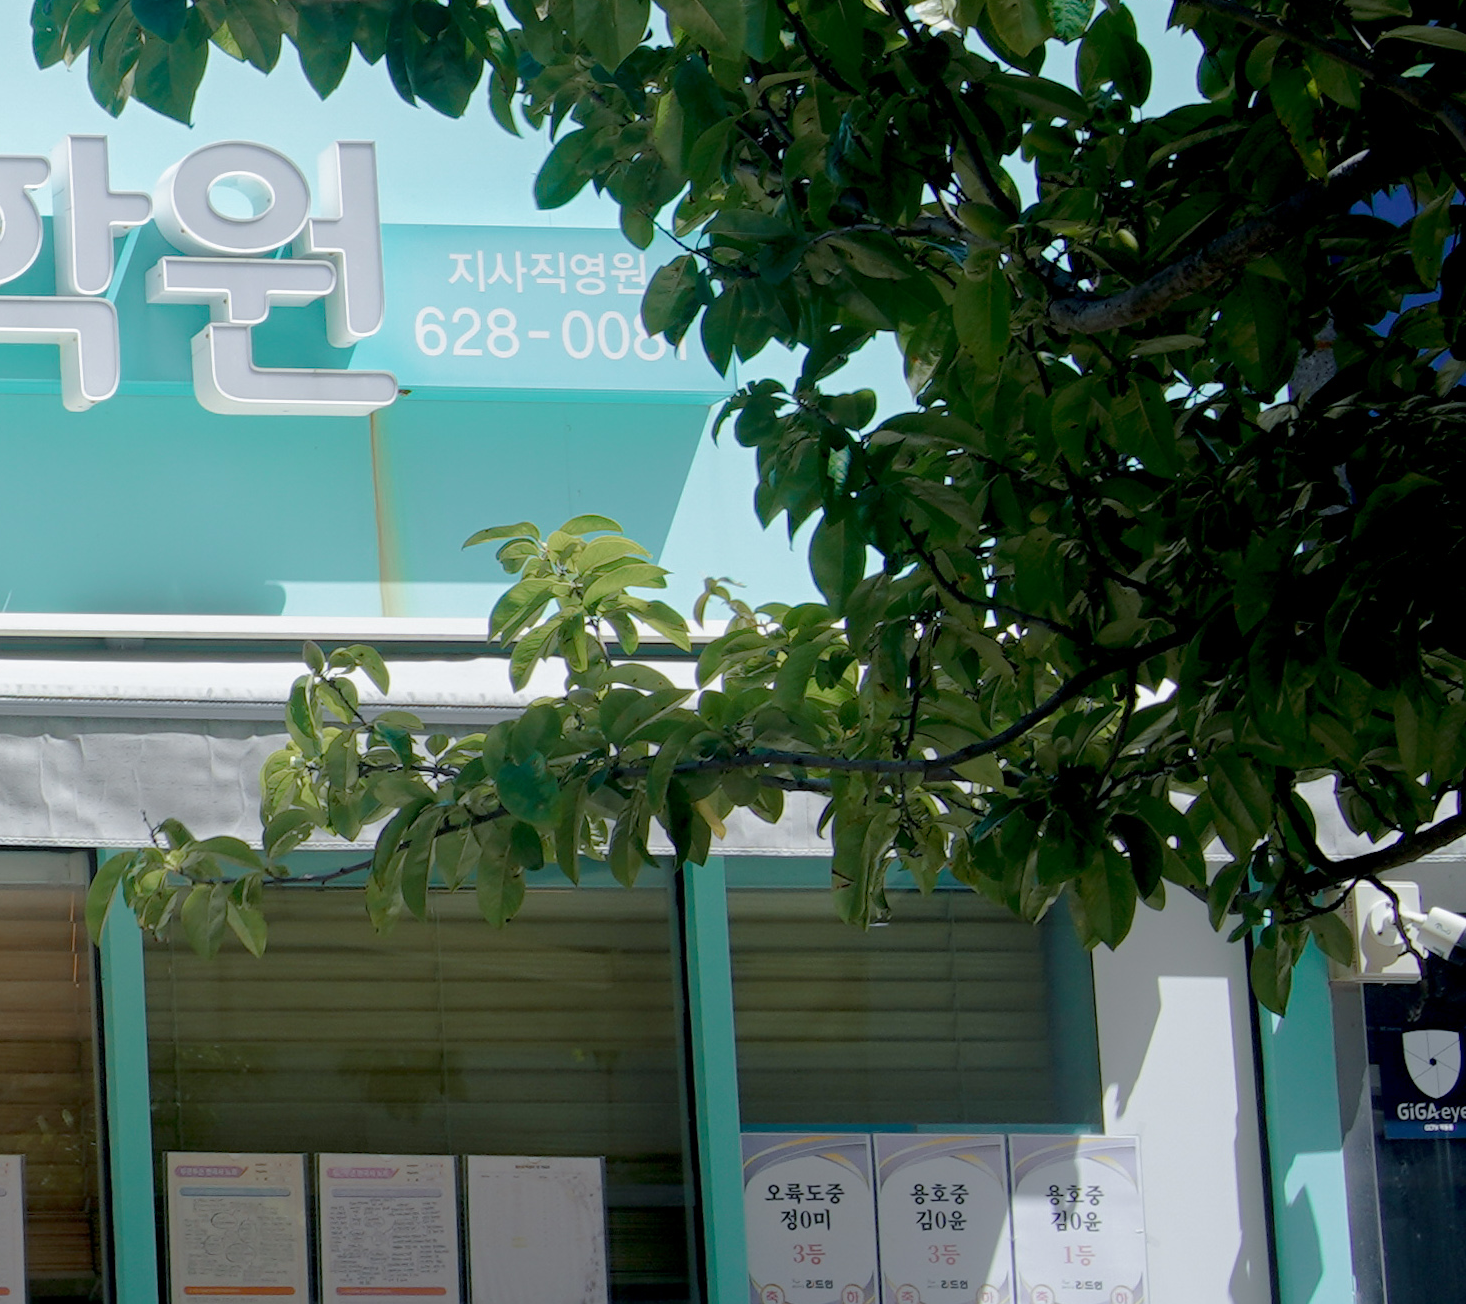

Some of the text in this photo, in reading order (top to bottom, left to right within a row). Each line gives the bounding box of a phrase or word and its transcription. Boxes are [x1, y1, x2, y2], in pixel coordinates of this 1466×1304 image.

[449, 251, 647, 295] 지사직영원
[766, 1183, 845, 1204] 오륙도중
[910, 1183, 969, 1205] 용호중
[1046, 1185, 1104, 1206] 용호중
[794, 1244, 826, 1265] 3등
[928, 1244, 960, 1266] 3등
[1064, 1244, 1095, 1266] 1등
